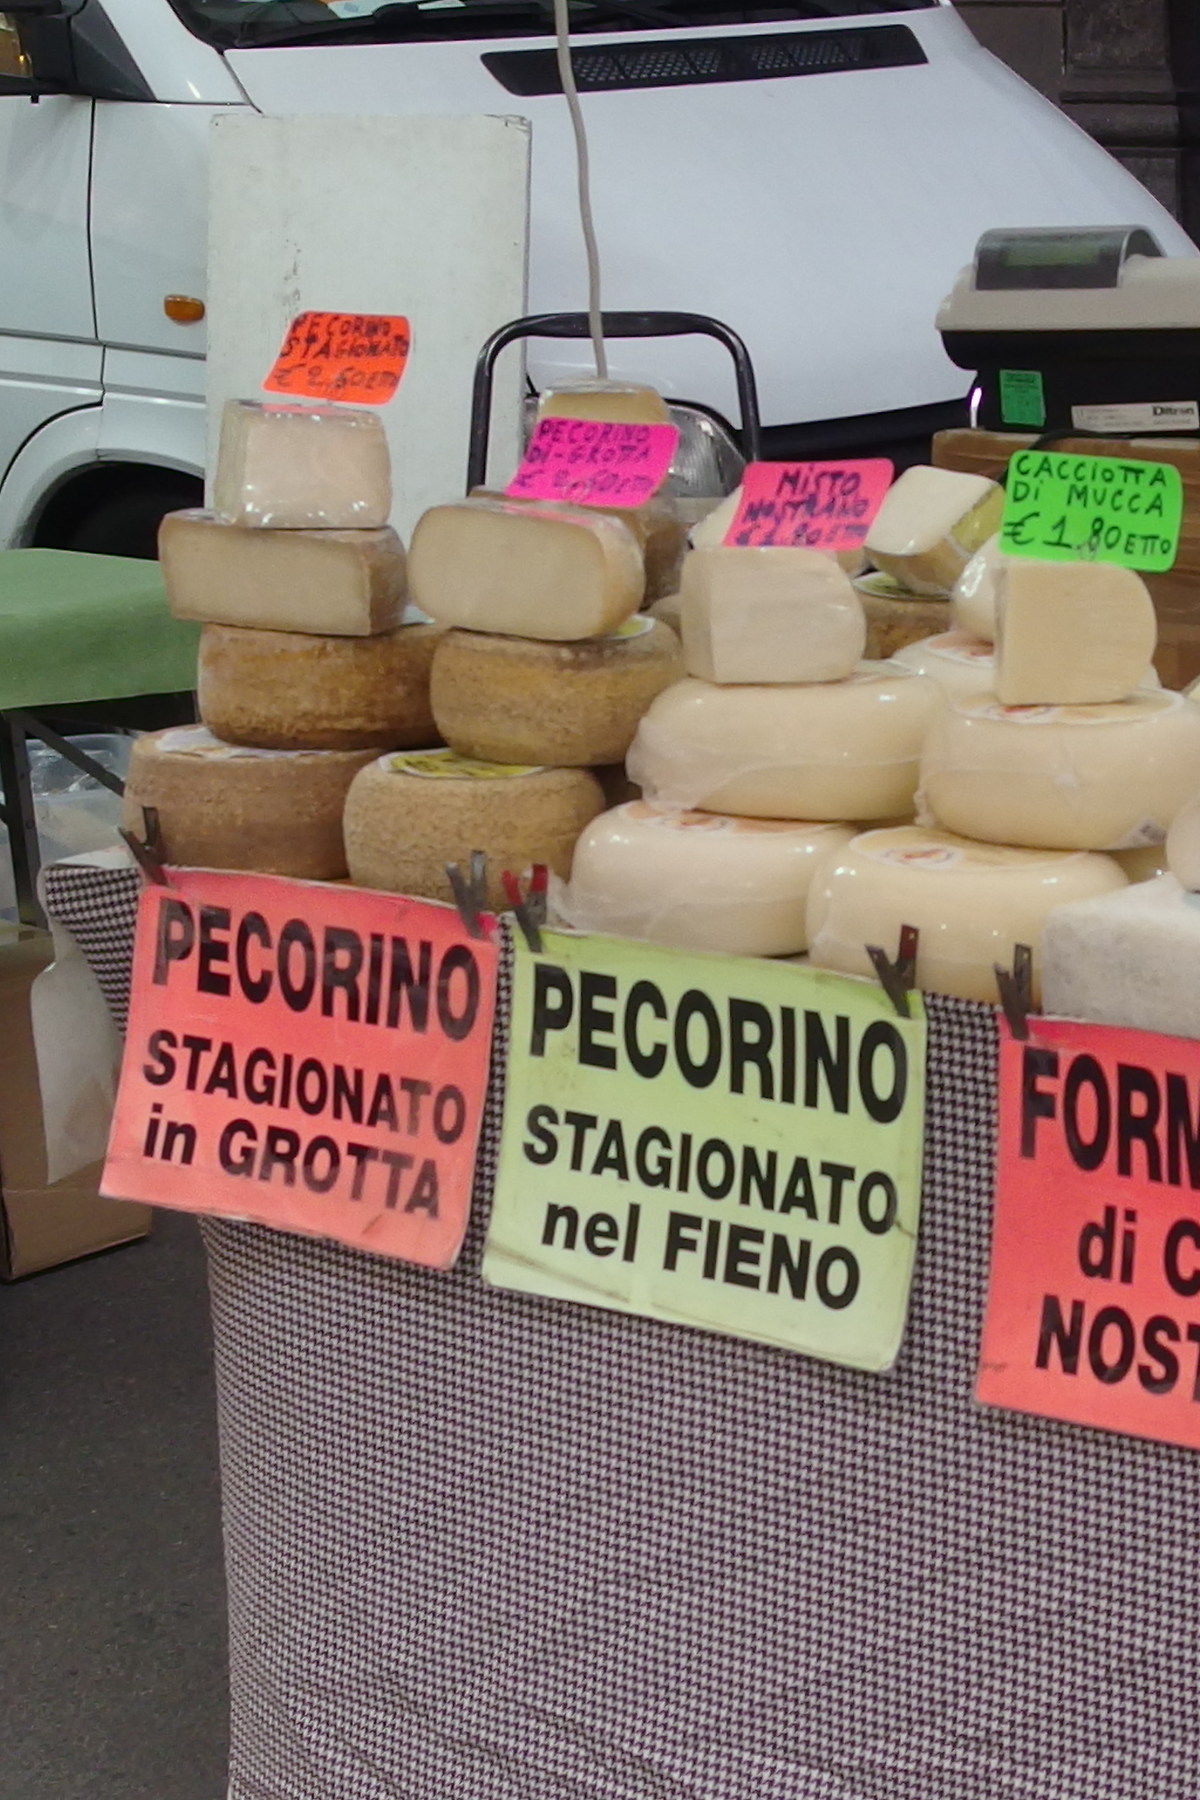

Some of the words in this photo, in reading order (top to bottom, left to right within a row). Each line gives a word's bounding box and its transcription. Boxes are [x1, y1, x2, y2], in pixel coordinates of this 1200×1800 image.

[1015, 454, 1167, 487] CACCIOTTA
[1066, 483, 1164, 518] MUCCA
[151, 896, 481, 1042] PECORINO
[142, 1028, 466, 1145] STAGIONATO
[529, 962, 908, 1124] PECORINO
[142, 1102, 198, 1166] in
[217, 1117, 440, 1220] GROTTA
[522, 1103, 899, 1236] STAGIONATO
[541, 1202, 642, 1264] nel
[662, 1210, 860, 1311] FIENO
[1077, 1203, 1138, 1285] di
